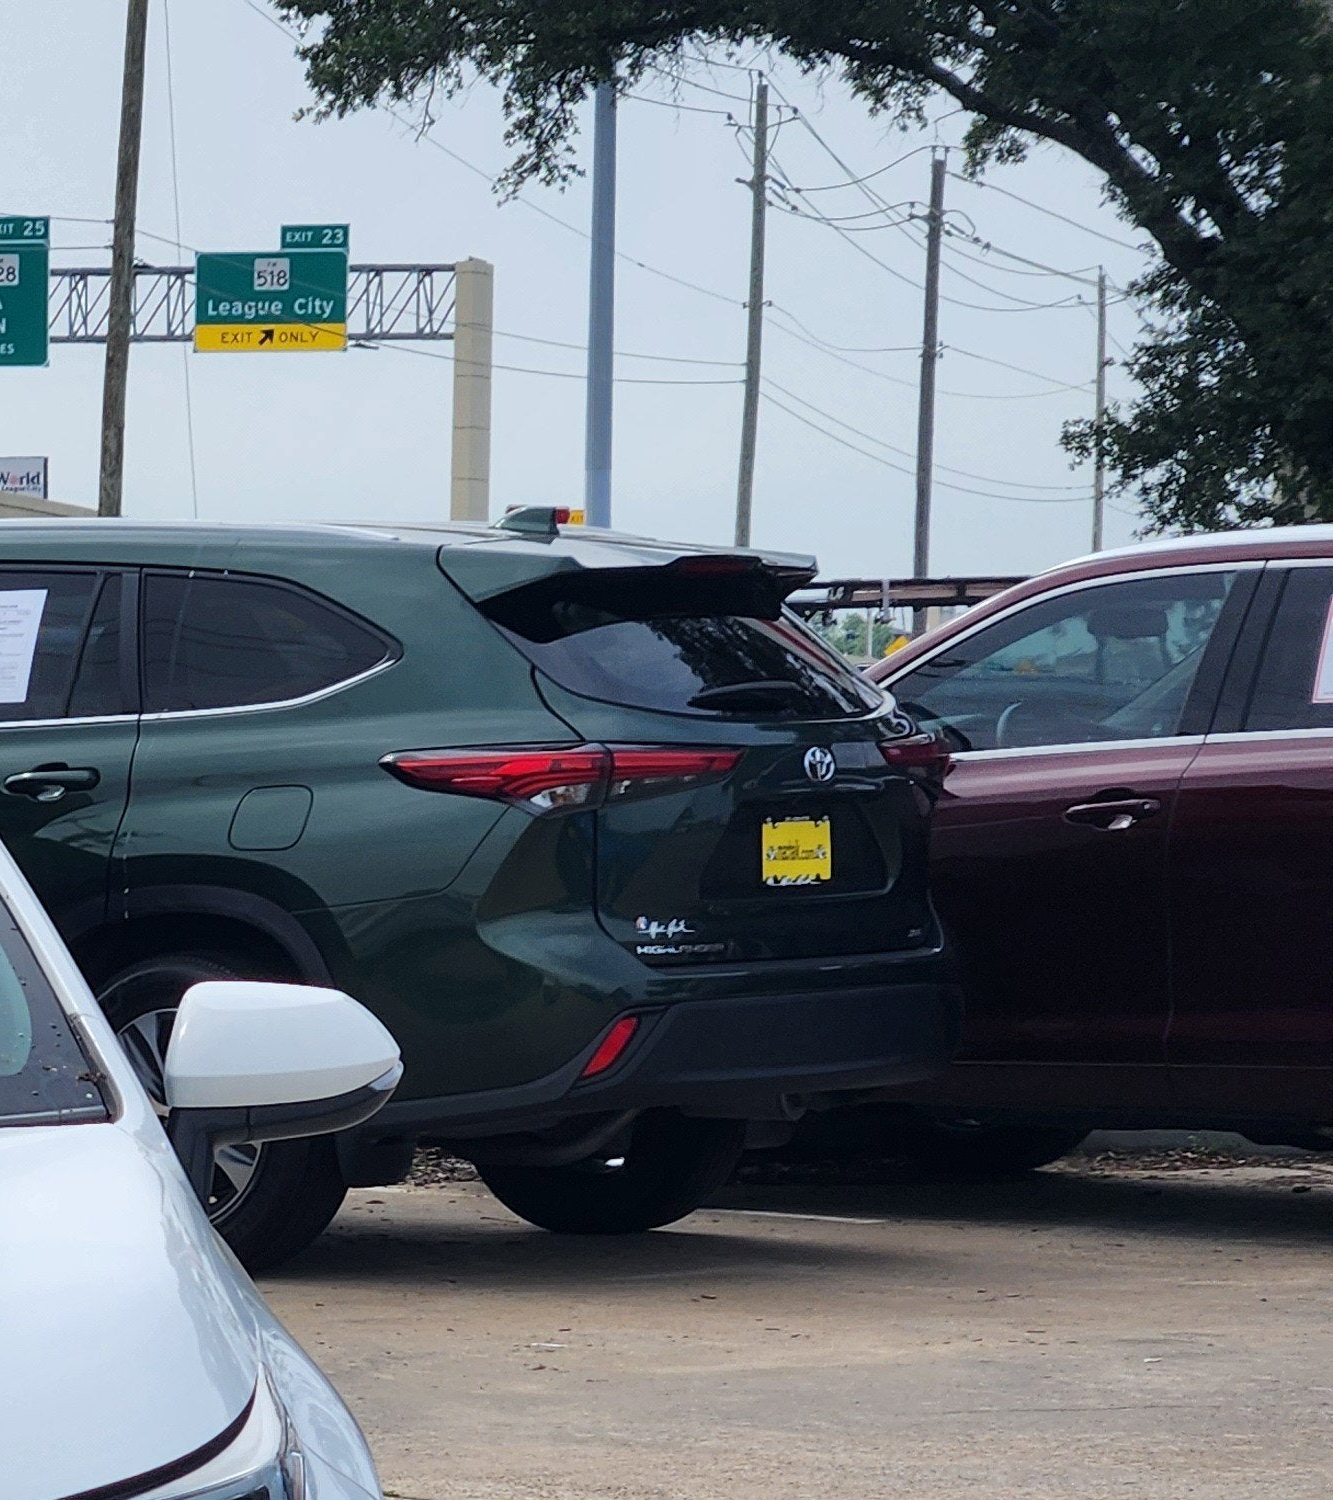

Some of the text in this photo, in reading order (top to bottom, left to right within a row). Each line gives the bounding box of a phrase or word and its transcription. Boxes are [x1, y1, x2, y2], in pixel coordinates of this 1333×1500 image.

[23, 220, 45, 236] 25
[286, 229, 344, 244] EXIT 23
[256, 269, 288, 287] 518
[207, 296, 334, 320] League City
[220, 330, 320, 344] EXIT ONLY
